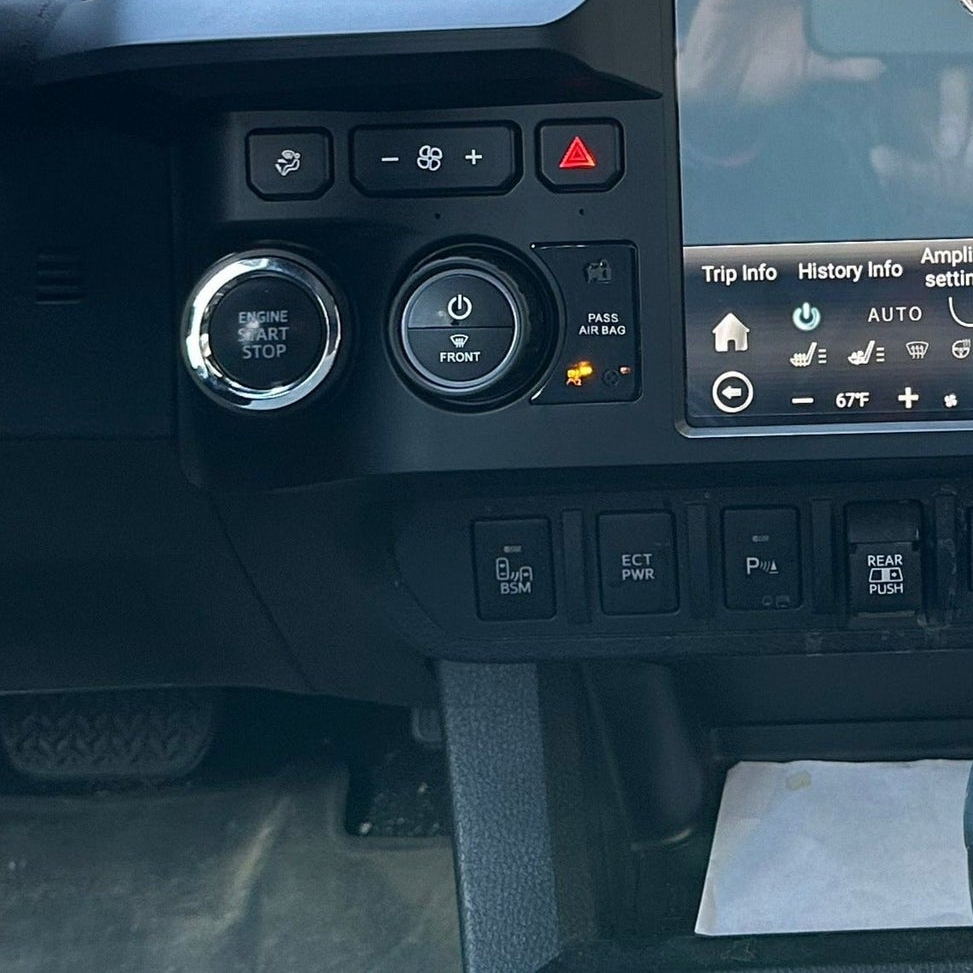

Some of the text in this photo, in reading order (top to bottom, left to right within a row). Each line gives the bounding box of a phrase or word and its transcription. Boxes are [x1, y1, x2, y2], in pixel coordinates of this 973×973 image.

[701, 263, 778, 285] Trip Info
[798, 259, 903, 283] History Info
[238, 310, 289, 324] ENGINE
[587, 313, 620, 324] PASS
[867, 306, 923, 323] AUTO
[237, 326, 290, 343] START
[578, 325, 626, 336] AIR BAG
[242, 343, 288, 360] STOP
[439, 351, 481, 363] FRONT
[621, 552, 653, 567] ECT
[867, 554, 903, 567] REAR
[621, 567, 655, 581] PWR
[500, 581, 532, 595] BSM
[868, 582, 904, 595] PUSH
